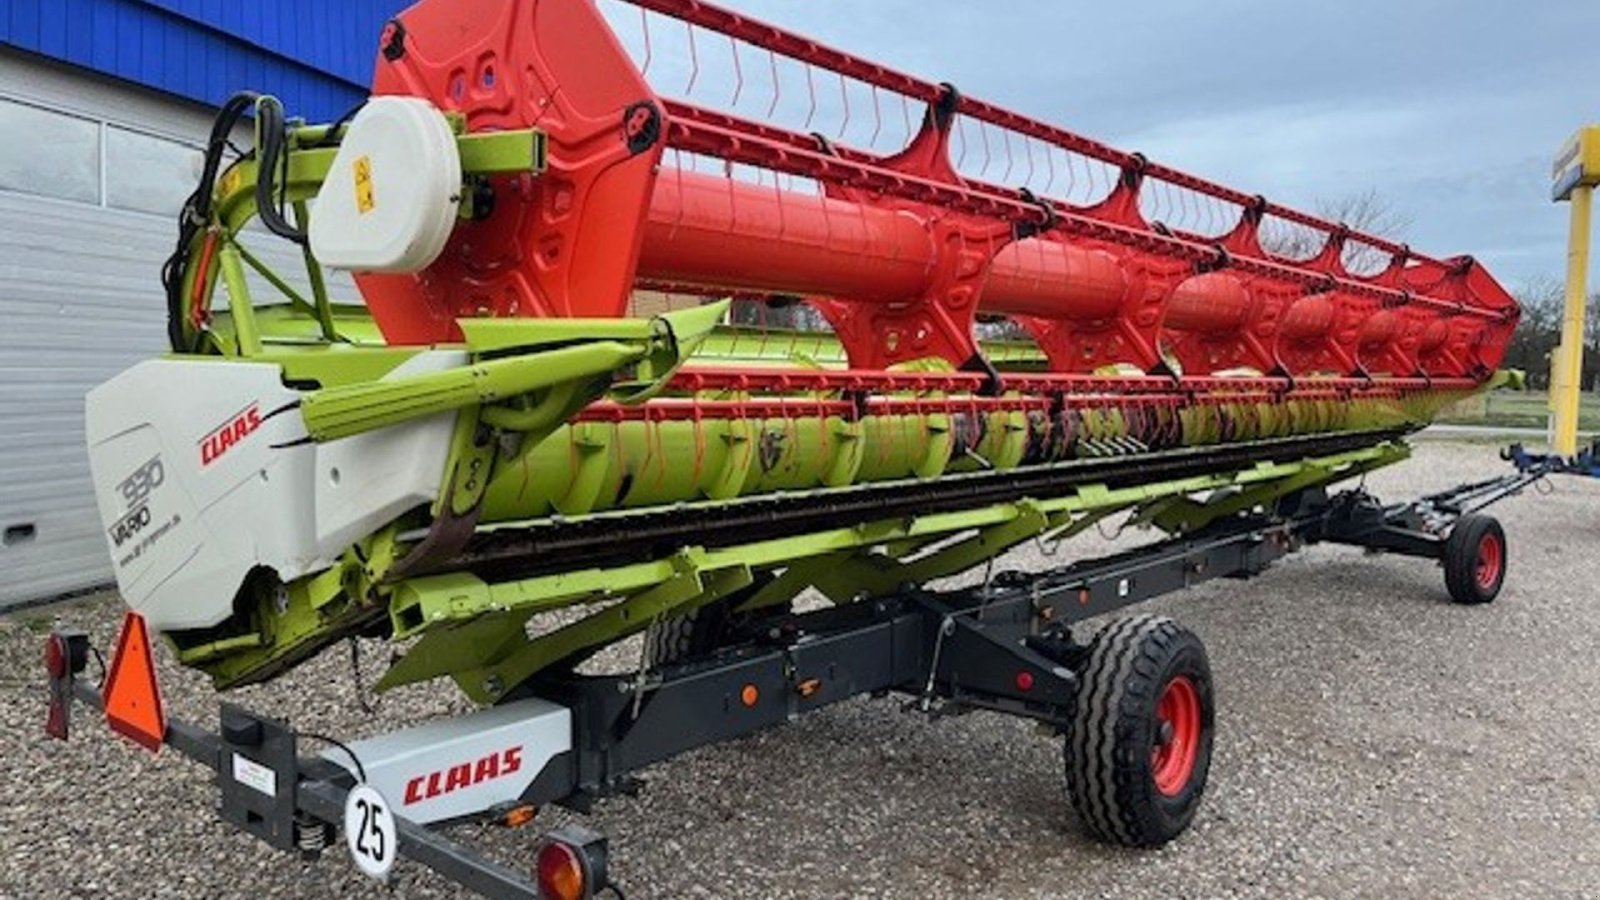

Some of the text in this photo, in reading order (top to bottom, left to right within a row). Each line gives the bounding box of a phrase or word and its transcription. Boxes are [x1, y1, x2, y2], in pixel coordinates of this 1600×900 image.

[201, 406, 262, 466] CLAAS
[109, 505, 151, 547] VARIO
[403, 745, 524, 806] CLAAS
[355, 799, 384, 862] 25
